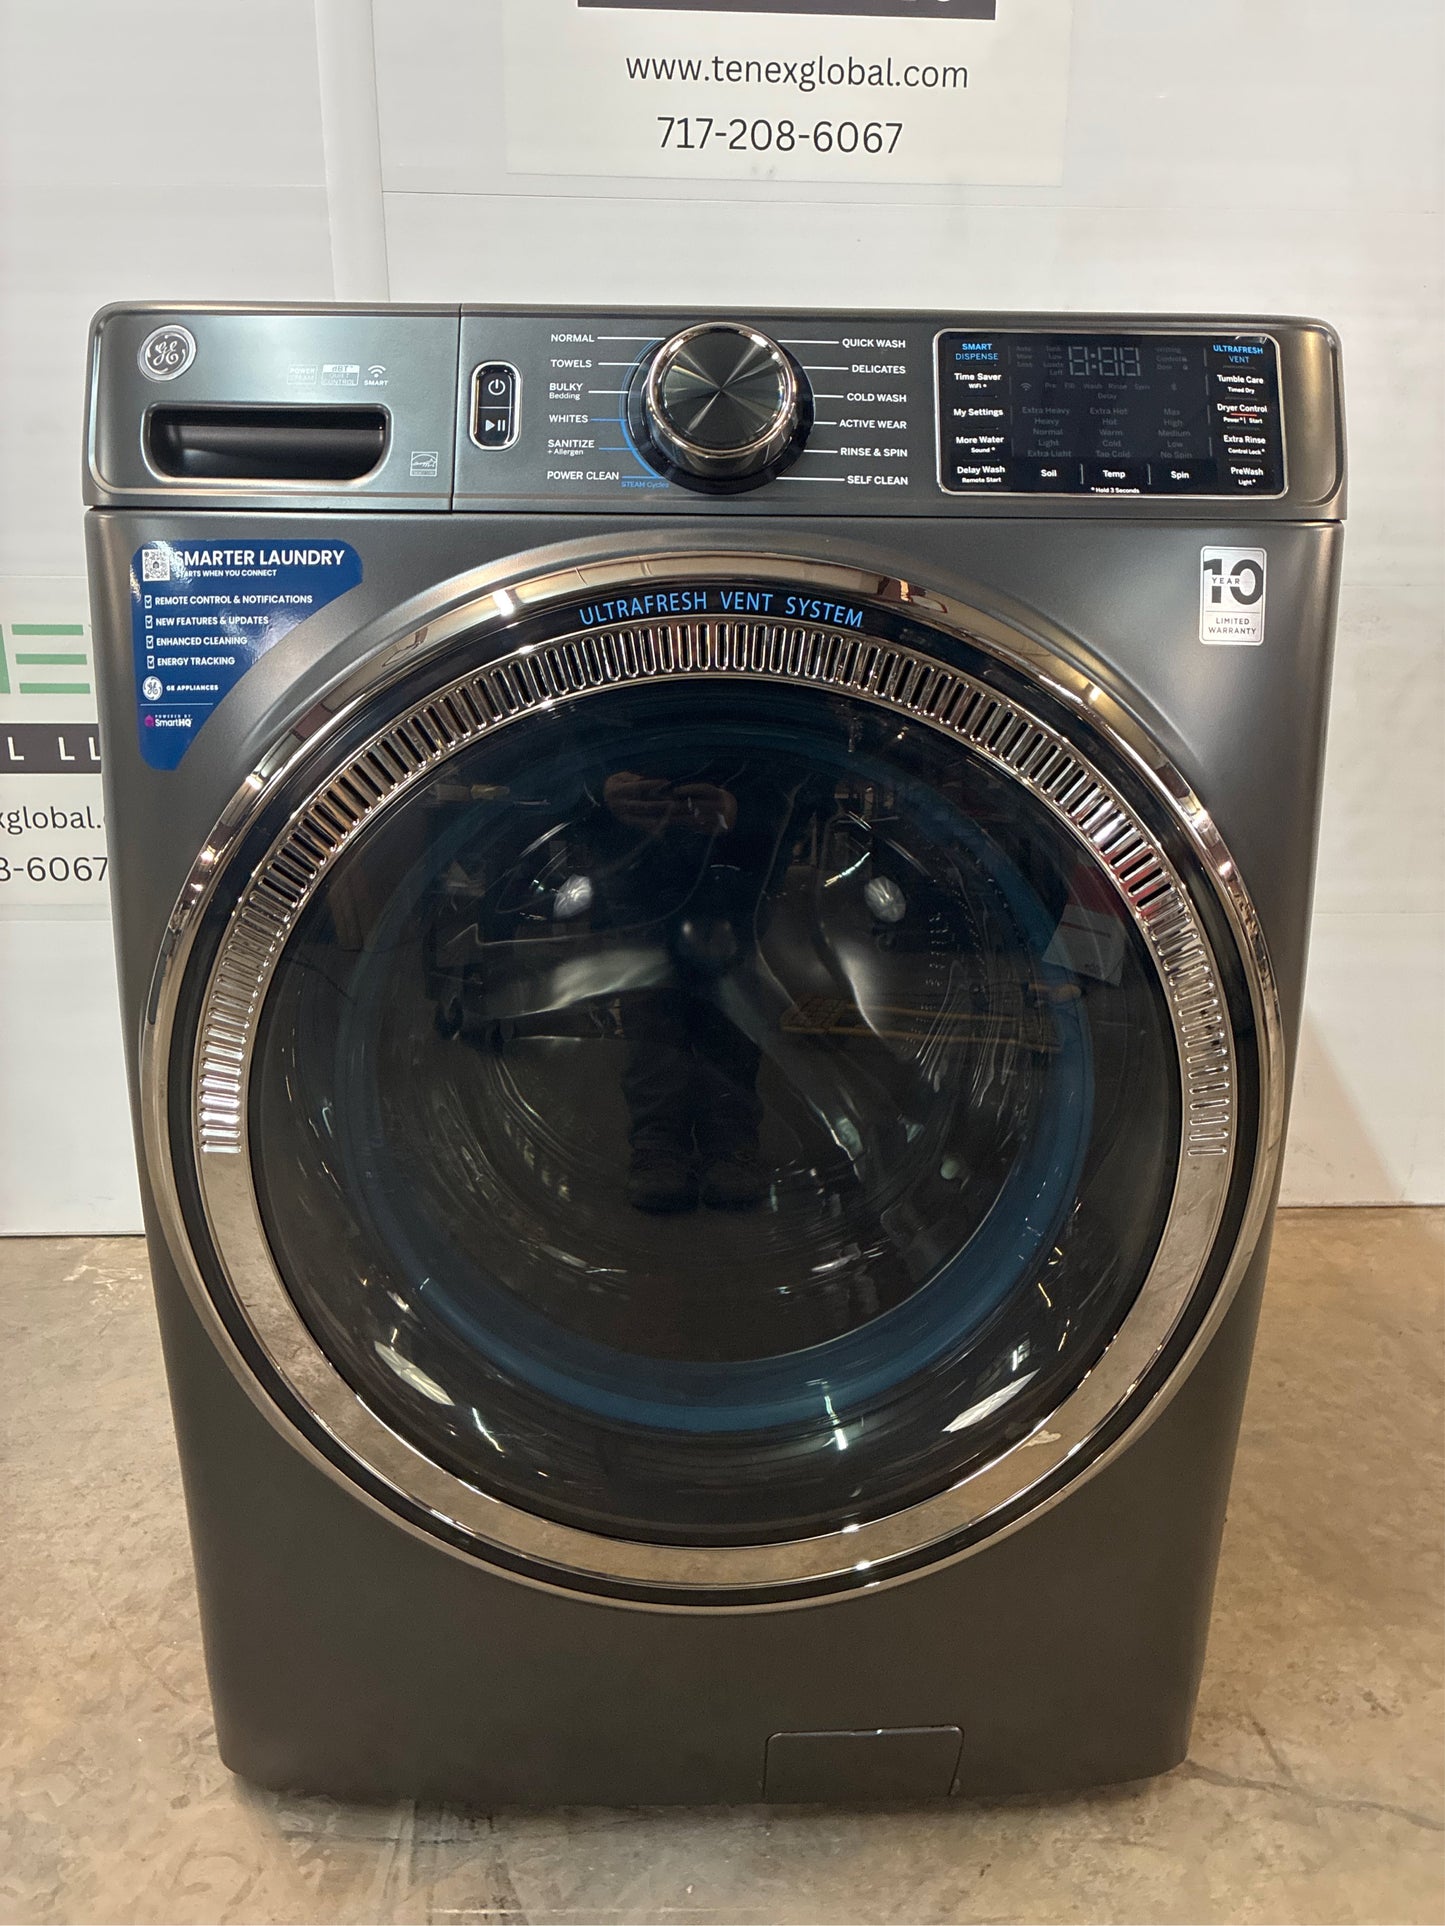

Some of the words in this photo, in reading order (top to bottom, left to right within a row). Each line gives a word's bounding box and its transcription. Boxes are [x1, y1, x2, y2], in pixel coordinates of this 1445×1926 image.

[625, 55, 970, 92] www.tenexglobal.com
[656, 116, 904, 154] 717-208-6067
[550, 333, 596, 343] NORMAL
[841, 338, 875, 348] QUICK
[876, 339, 906, 349] WASH
[961, 343, 993, 351] SMART
[1212, 344, 1264, 354] ULTRAFRESH
[954, 353, 999, 361] DISPENSE
[1228, 356, 1250, 364] VENT
[550, 359, 593, 369] TOWELS
[851, 364, 907, 375] DELICATES
[953, 372, 976, 381] Time
[977, 372, 1002, 381] Saver
[1216, 374, 1245, 383] Tumble
[1245, 376, 1264, 384] Care
[549, 382, 584, 392] BULKY
[1244, 387, 1255, 395] Dry
[549, 392, 581, 401] Bedding
[846, 392, 873, 402] COLD
[877, 393, 907, 403] WASH
[953, 408, 967, 418] My
[967, 408, 1004, 418] Settings
[1045, 407, 1070, 416] Heavy
[1089, 407, 1111, 415] Extra
[1216, 403, 1238, 413] Dryer
[1239, 404, 1268, 413] Control
[548, 414, 589, 424] WHITES
[1034, 418, 1060, 427] Heavy
[1163, 419, 1183, 428] High
[839, 419, 875, 429] ACTIVE
[877, 420, 907, 430] WEAR
[1032, 428, 1063, 436] Normal
[1157, 429, 1191, 437] Medium
[955, 436, 978, 444] More
[978, 436, 1005, 444] Water
[1038, 440, 1059, 448] Light
[1167, 440, 1183, 448] Low
[1223, 434, 1244, 443] Extra
[1244, 435, 1267, 444] Rinse
[547, 440, 595, 449] SANITIZE
[553, 448, 584, 457] Allergen
[840, 447, 871, 457] RINSE
[873, 448, 881, 458] &
[883, 448, 908, 458] SPIN
[1227, 447, 1248, 455] Control
[956, 466, 981, 475] Delay
[982, 466, 1006, 474] Wash
[1040, 469, 1058, 477] Soil
[1102, 469, 1126, 480] Temp
[1170, 470, 1190, 480] Spin
[1230, 466, 1264, 476] PreWash
[547, 471, 584, 481] POWER
[586, 471, 620, 481] CLEAN
[846, 475, 871, 485] SELF
[873, 476, 909, 486] CLEAN
[646, 481, 669, 489] Cycles
[1237, 478, 1252, 486] Light
[1095, 486, 1109, 494] Hold
[1115, 487, 1140, 495] Seconds
[175, 549, 255, 566] SMARTER
[259, 549, 345, 566] LAUNDRY
[202, 569, 224, 577] WHEN
[224, 569, 241, 577] YOU
[241, 569, 277, 577] CONNECT
[1203, 558, 1264, 606] 10
[1211, 577, 1241, 585] YEAR
[154, 596, 189, 606] REMOTE
[189, 595, 232, 605] CONTROL
[233, 596, 241, 604] &
[242, 594, 313, 604] NOTIFICATIONS
[579, 591, 708, 626] ULTRAFRESH
[720, 591, 774, 612] VENT
[785, 596, 864, 628] SYSTEM
[155, 616, 176, 626] NEW
[176, 616, 218, 626] FEATURES
[219, 617, 227, 625] &
[228, 615, 269, 625] UPDATES
[1208, 626, 1257, 635] WARRANTY
[156, 637, 202, 647] ENHANCED
[202, 636, 248, 646] CLEANING
[157, 657, 189, 667] ENERGY
[190, 656, 236, 666] TRACKING
[155, 717, 192, 727] SmartHQ
[0, 806, 106, 835] global.
